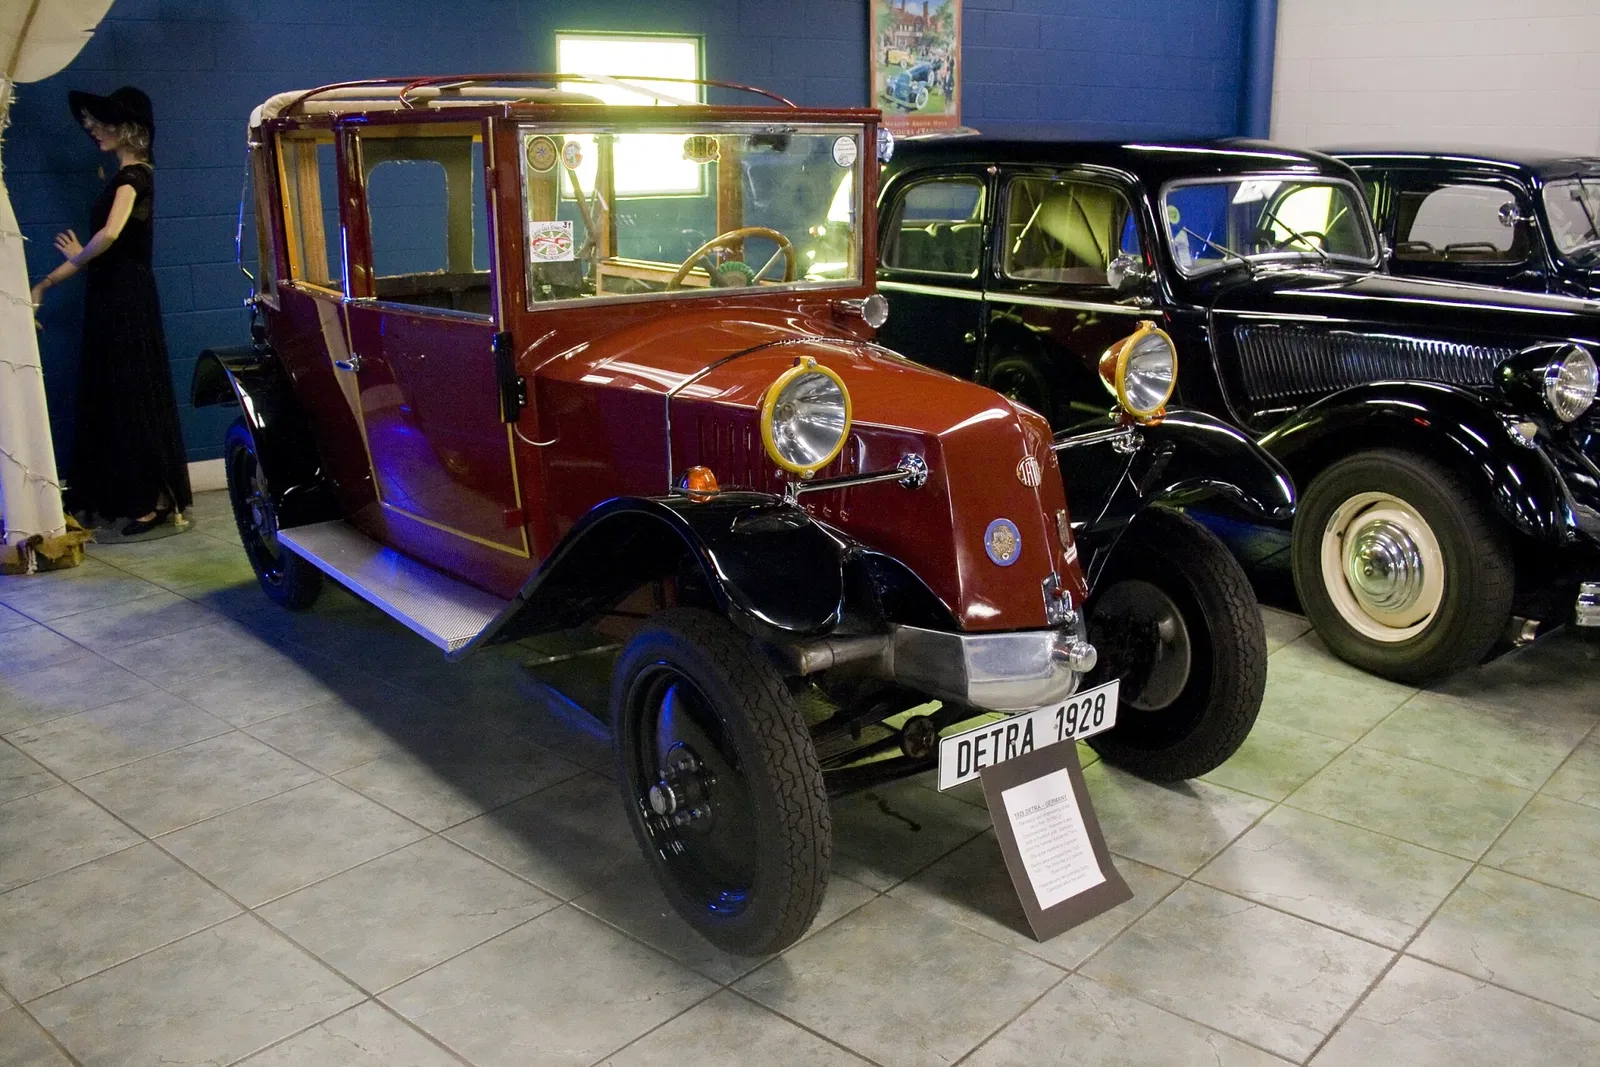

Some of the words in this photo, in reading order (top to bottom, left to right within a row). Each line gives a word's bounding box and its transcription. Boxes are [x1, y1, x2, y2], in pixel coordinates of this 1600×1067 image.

[957, 718, 1034, 778] DETRA
[1055, 693, 1106, 741] 1928
[1024, 804, 1041, 815] DETRA
[1044, 794, 1067, 808] GERMANY
